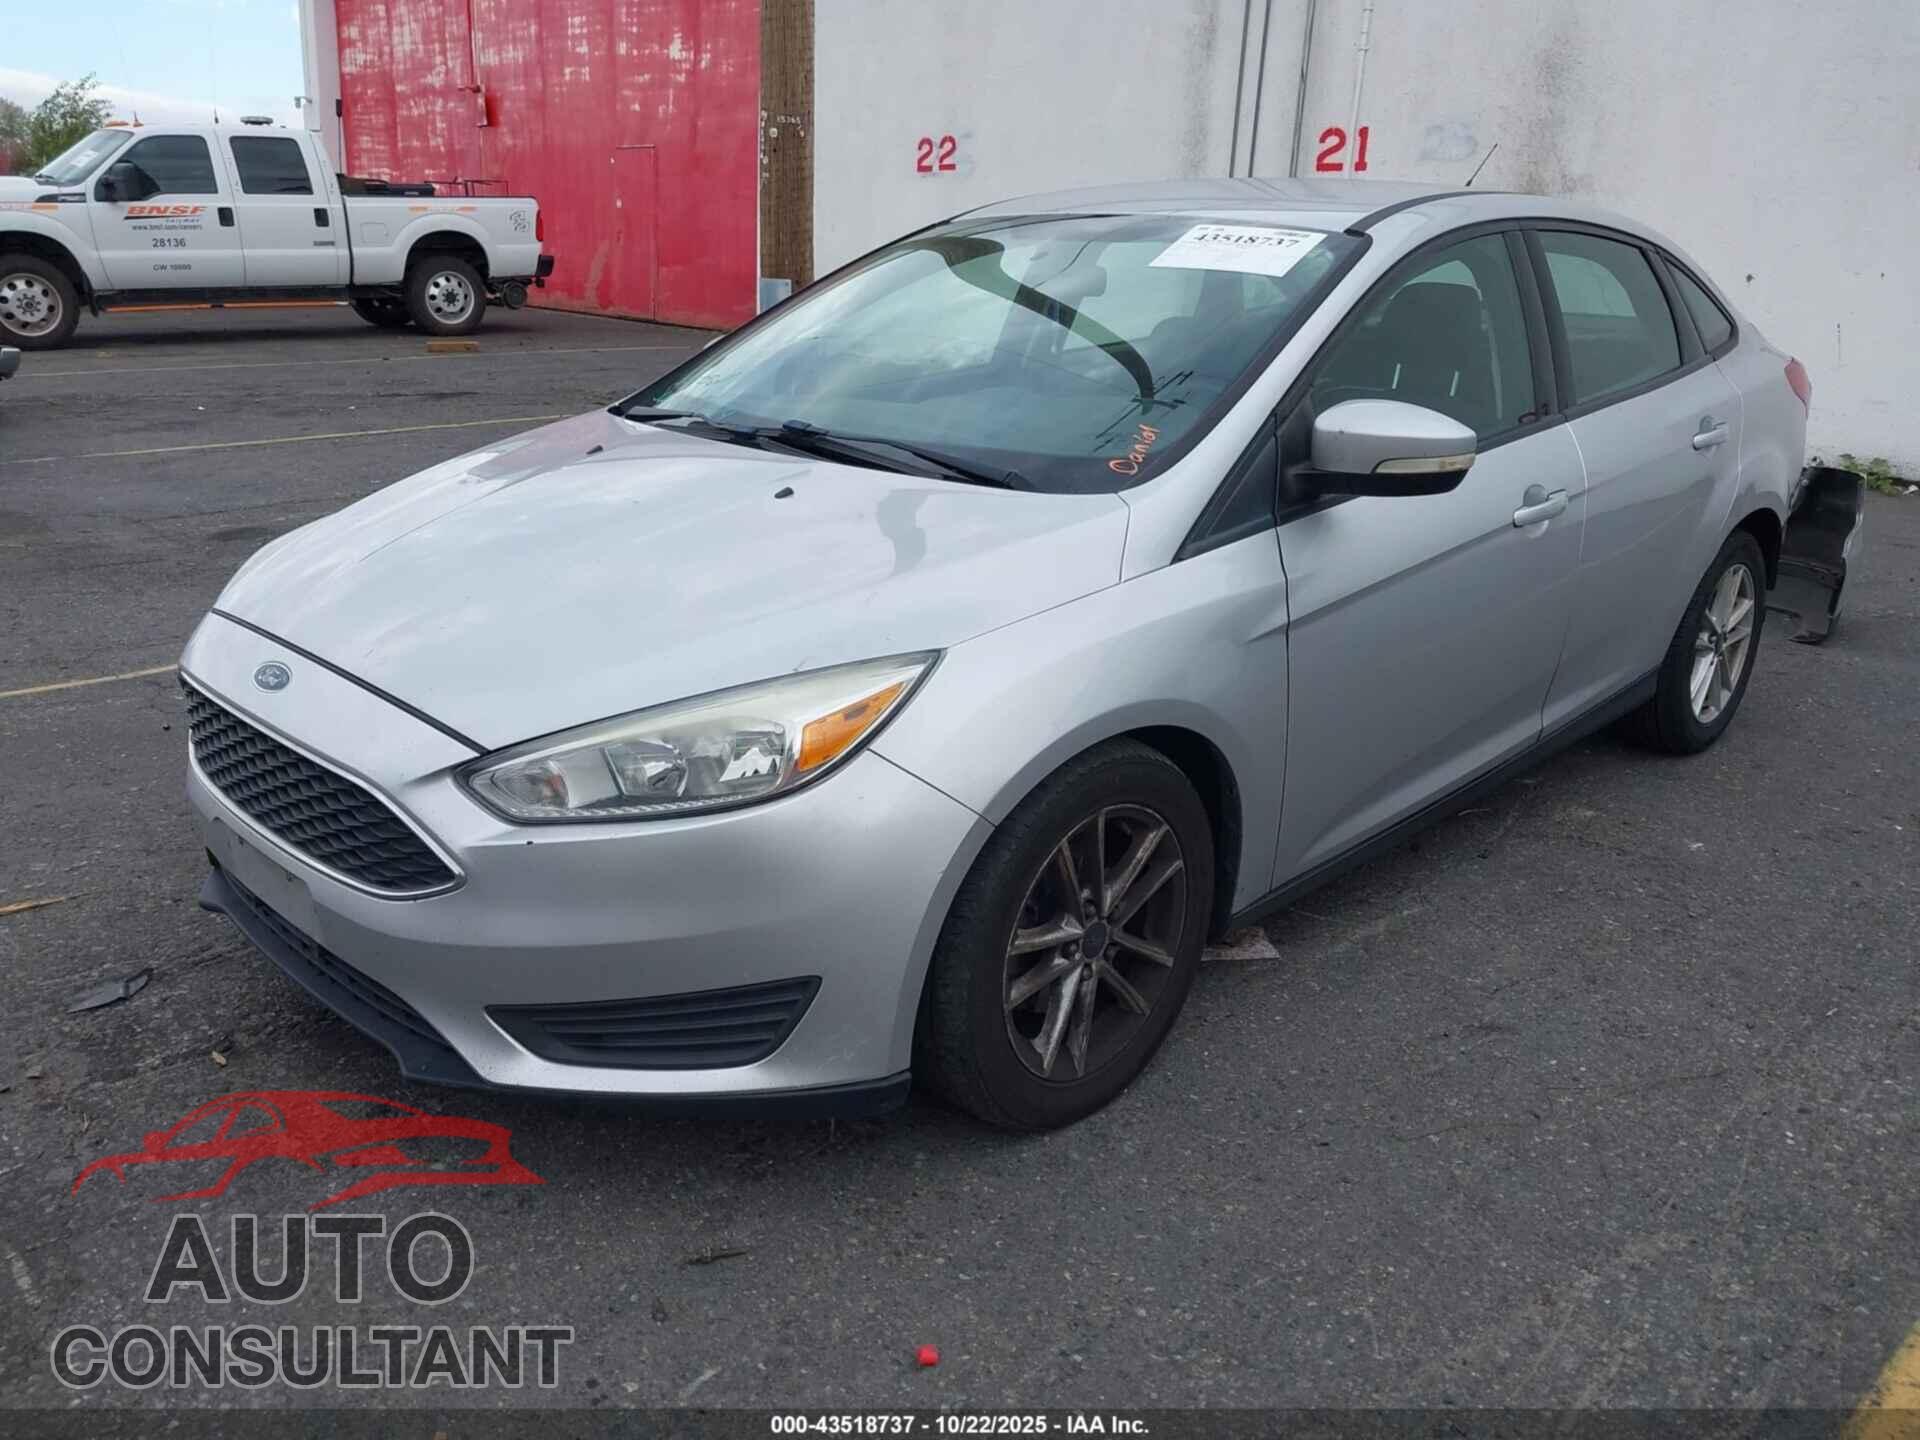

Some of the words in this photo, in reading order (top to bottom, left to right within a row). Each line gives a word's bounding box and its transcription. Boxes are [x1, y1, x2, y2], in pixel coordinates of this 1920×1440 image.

[917, 135, 956, 173] 22
[1316, 126, 1369, 172] 21
[128, 205, 209, 216] BNSF
[152, 238, 187, 249] 28136
